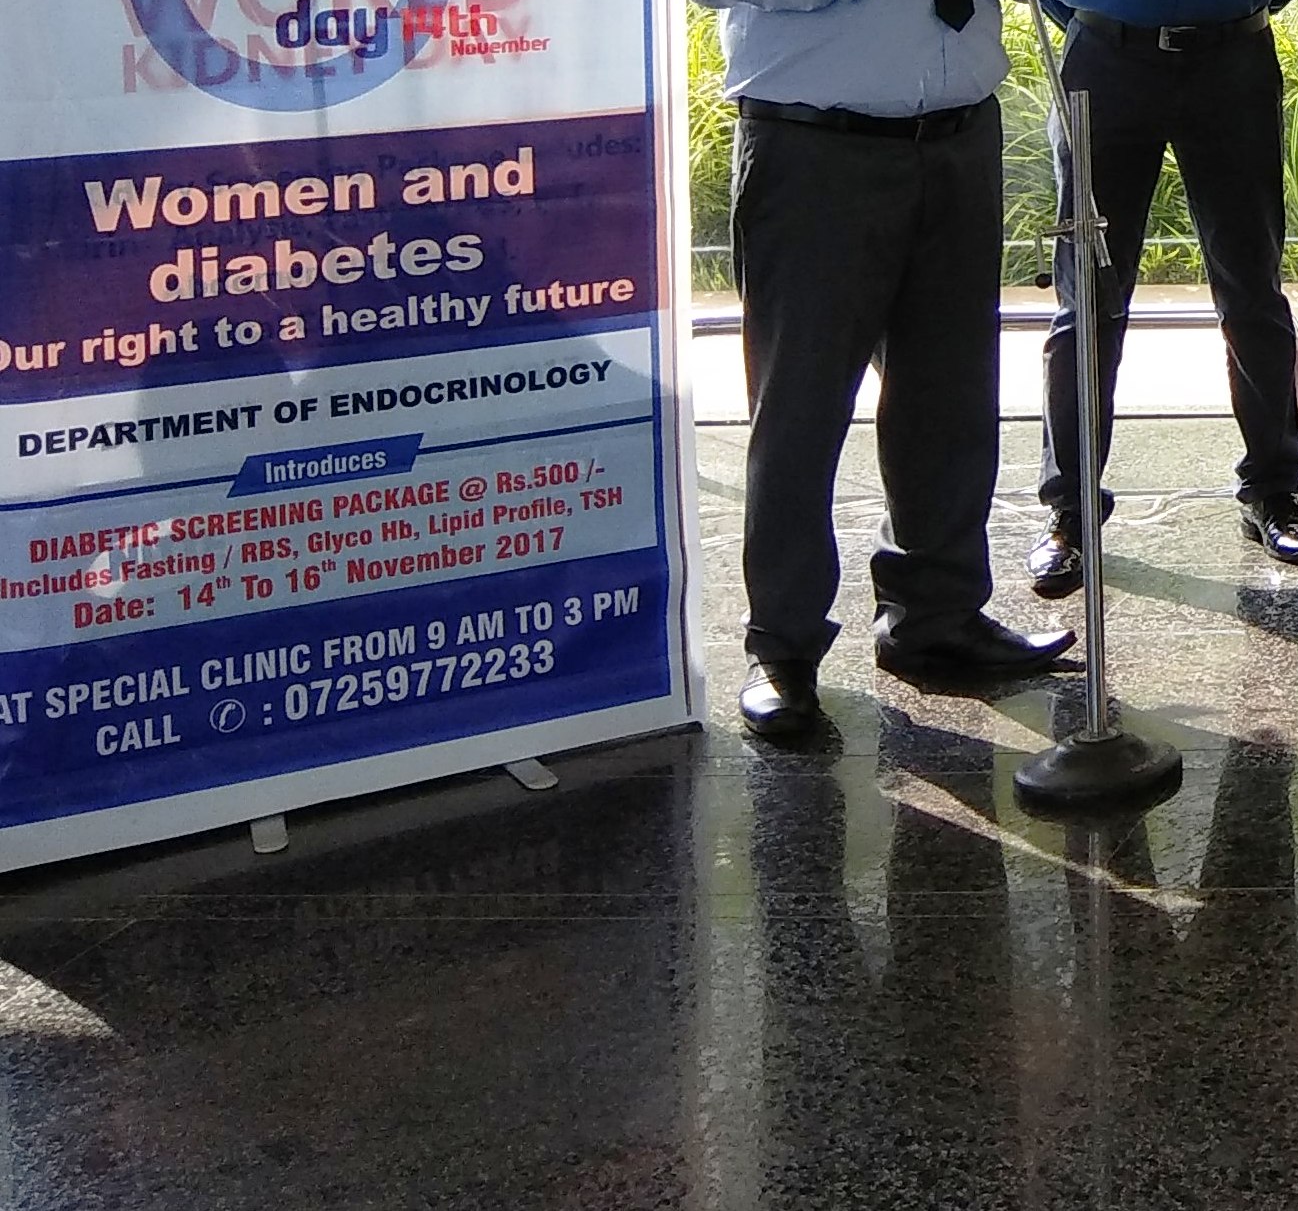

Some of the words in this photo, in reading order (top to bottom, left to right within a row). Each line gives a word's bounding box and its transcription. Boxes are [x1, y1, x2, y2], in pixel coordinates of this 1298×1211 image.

[400, 2, 498, 42] 14th
[450, 36, 551, 57] November
[84, 172, 376, 233] Women
[402, 146, 536, 204] and
[149, 231, 485, 303] diabetes
[82, 320, 199, 366] right
[214, 315, 262, 348] to
[279, 314, 306, 341] a
[322, 292, 492, 336] healthy
[504, 276, 636, 315] future
[18, 404, 263, 458] DEPARTMENT
[273, 397, 318, 424] OF
[329, 359, 613, 418] ENDOCRINOLOGY
[29, 521, 160, 564] DIABETIC
[170, 498, 324, 543] SCREENING
[332, 480, 451, 520] PACKAGE
[458, 476, 489, 502] @
[496, 460, 580, 495] Rs.500
[264, 448, 388, 485] Introduces
[0, 566, 113, 600] Includes
[121, 553, 216, 583] Fasting
[240, 536, 300, 564] RBS,
[307, 528, 374, 556] Glyco
[380, 519, 421, 543] Hb,
[428, 508, 485, 537] Lipid
[492, 497, 574, 526] Profile,
[579, 485, 623, 512] TSH
[73, 595, 156, 630] Date:
[240, 574, 274, 601] To
[346, 544, 487, 585] November
[496, 525, 565, 560] 2017
[44, 665, 191, 720] SPECIAL
[200, 643, 312, 691] CLINIC
[323, 624, 416, 670] FROM
[426, 620, 447, 651] 9
[456, 609, 505, 646] AM
[514, 600, 554, 635] TO
[563, 595, 583, 627] 3
[592, 585, 640, 622] PM
[95, 713, 182, 757] CALL
[284, 638, 555, 722] 07259772233
